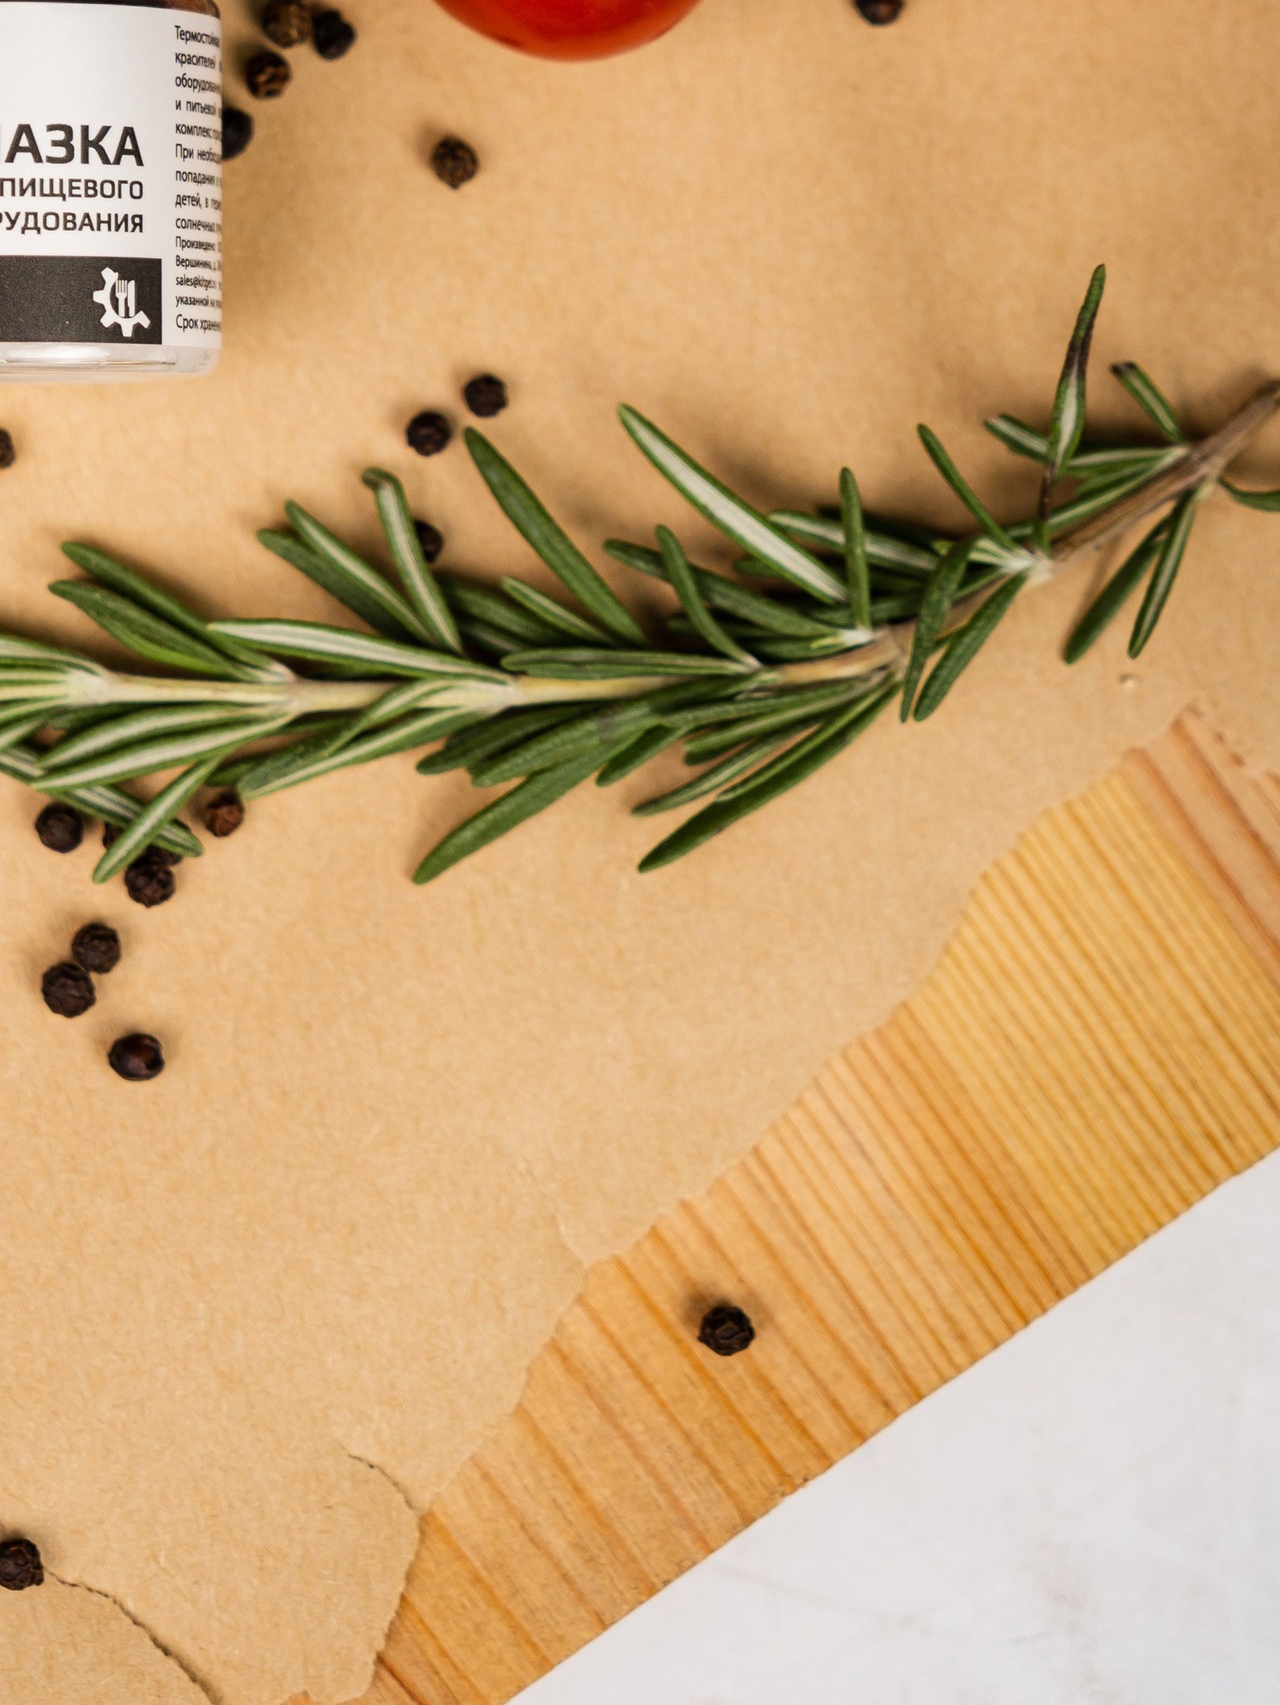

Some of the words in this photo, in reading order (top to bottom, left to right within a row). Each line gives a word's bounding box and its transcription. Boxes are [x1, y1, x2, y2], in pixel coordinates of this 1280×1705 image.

[175, 100, 181, 110] и
[175, 143, 194, 162] При
[0, 178, 144, 202] ПИЩЕВОГО
[175, 192, 202, 209] детей,
[175, 313, 198, 333] Срок
